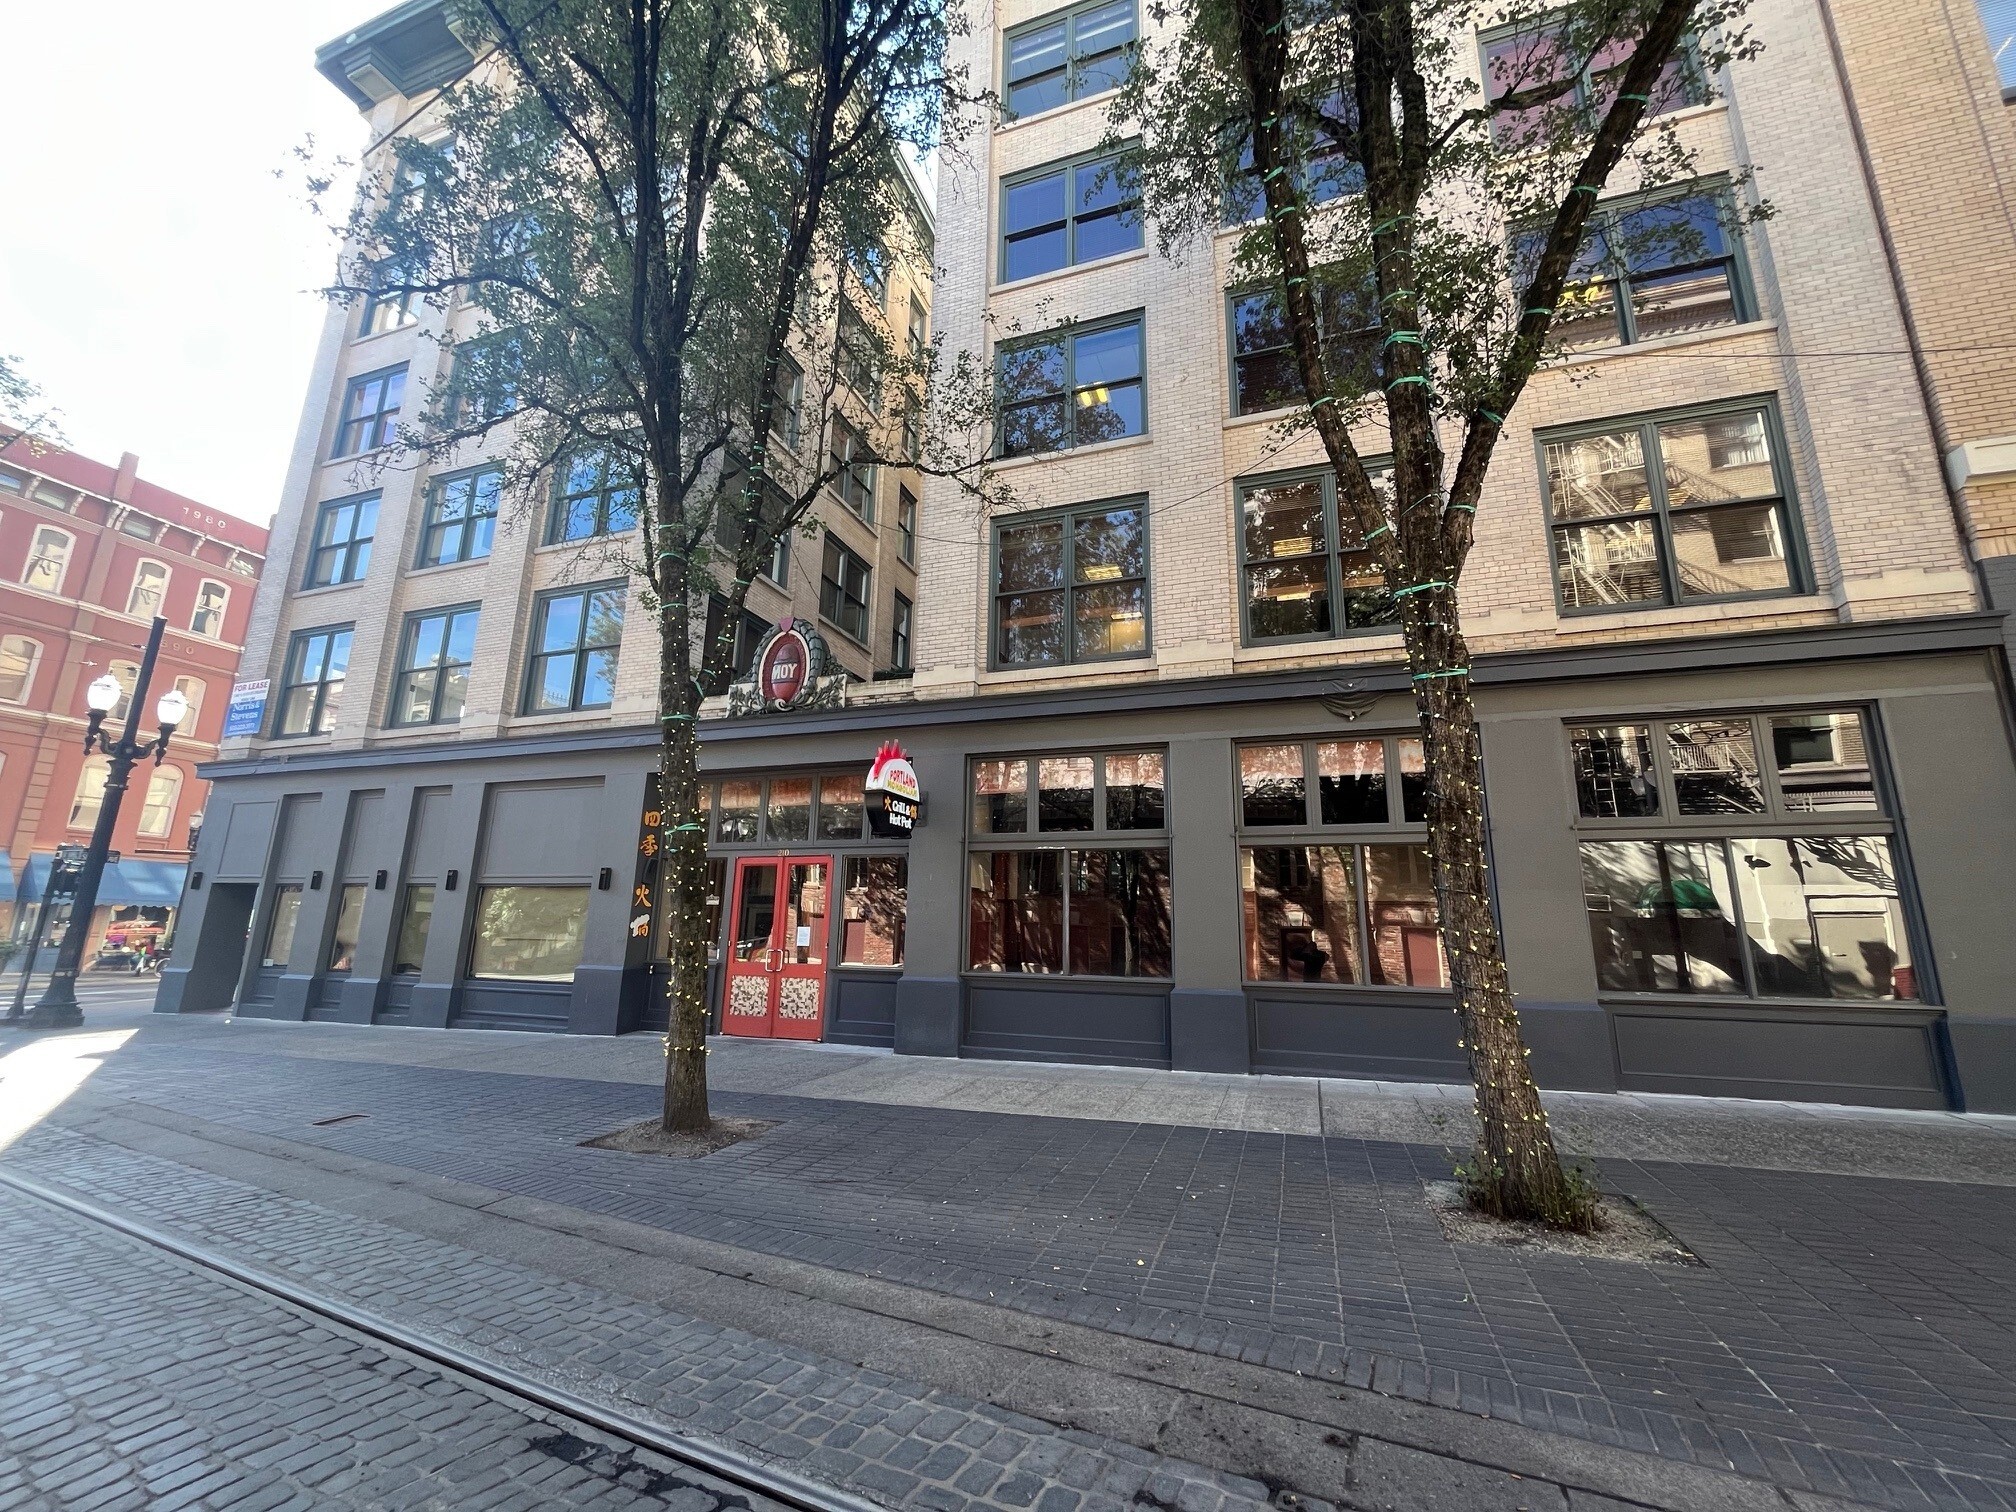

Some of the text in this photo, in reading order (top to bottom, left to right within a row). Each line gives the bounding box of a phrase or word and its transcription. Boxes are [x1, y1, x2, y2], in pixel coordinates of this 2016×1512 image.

[771, 663, 798, 680] MOY
[248, 681, 268, 691] LEASE
[232, 702, 254, 712] Norris
[230, 712, 258, 721] Stevens
[889, 770, 916, 788] PORTLAND
[889, 812, 912, 829] Hot Pot
[777, 848, 790, 857] 210
